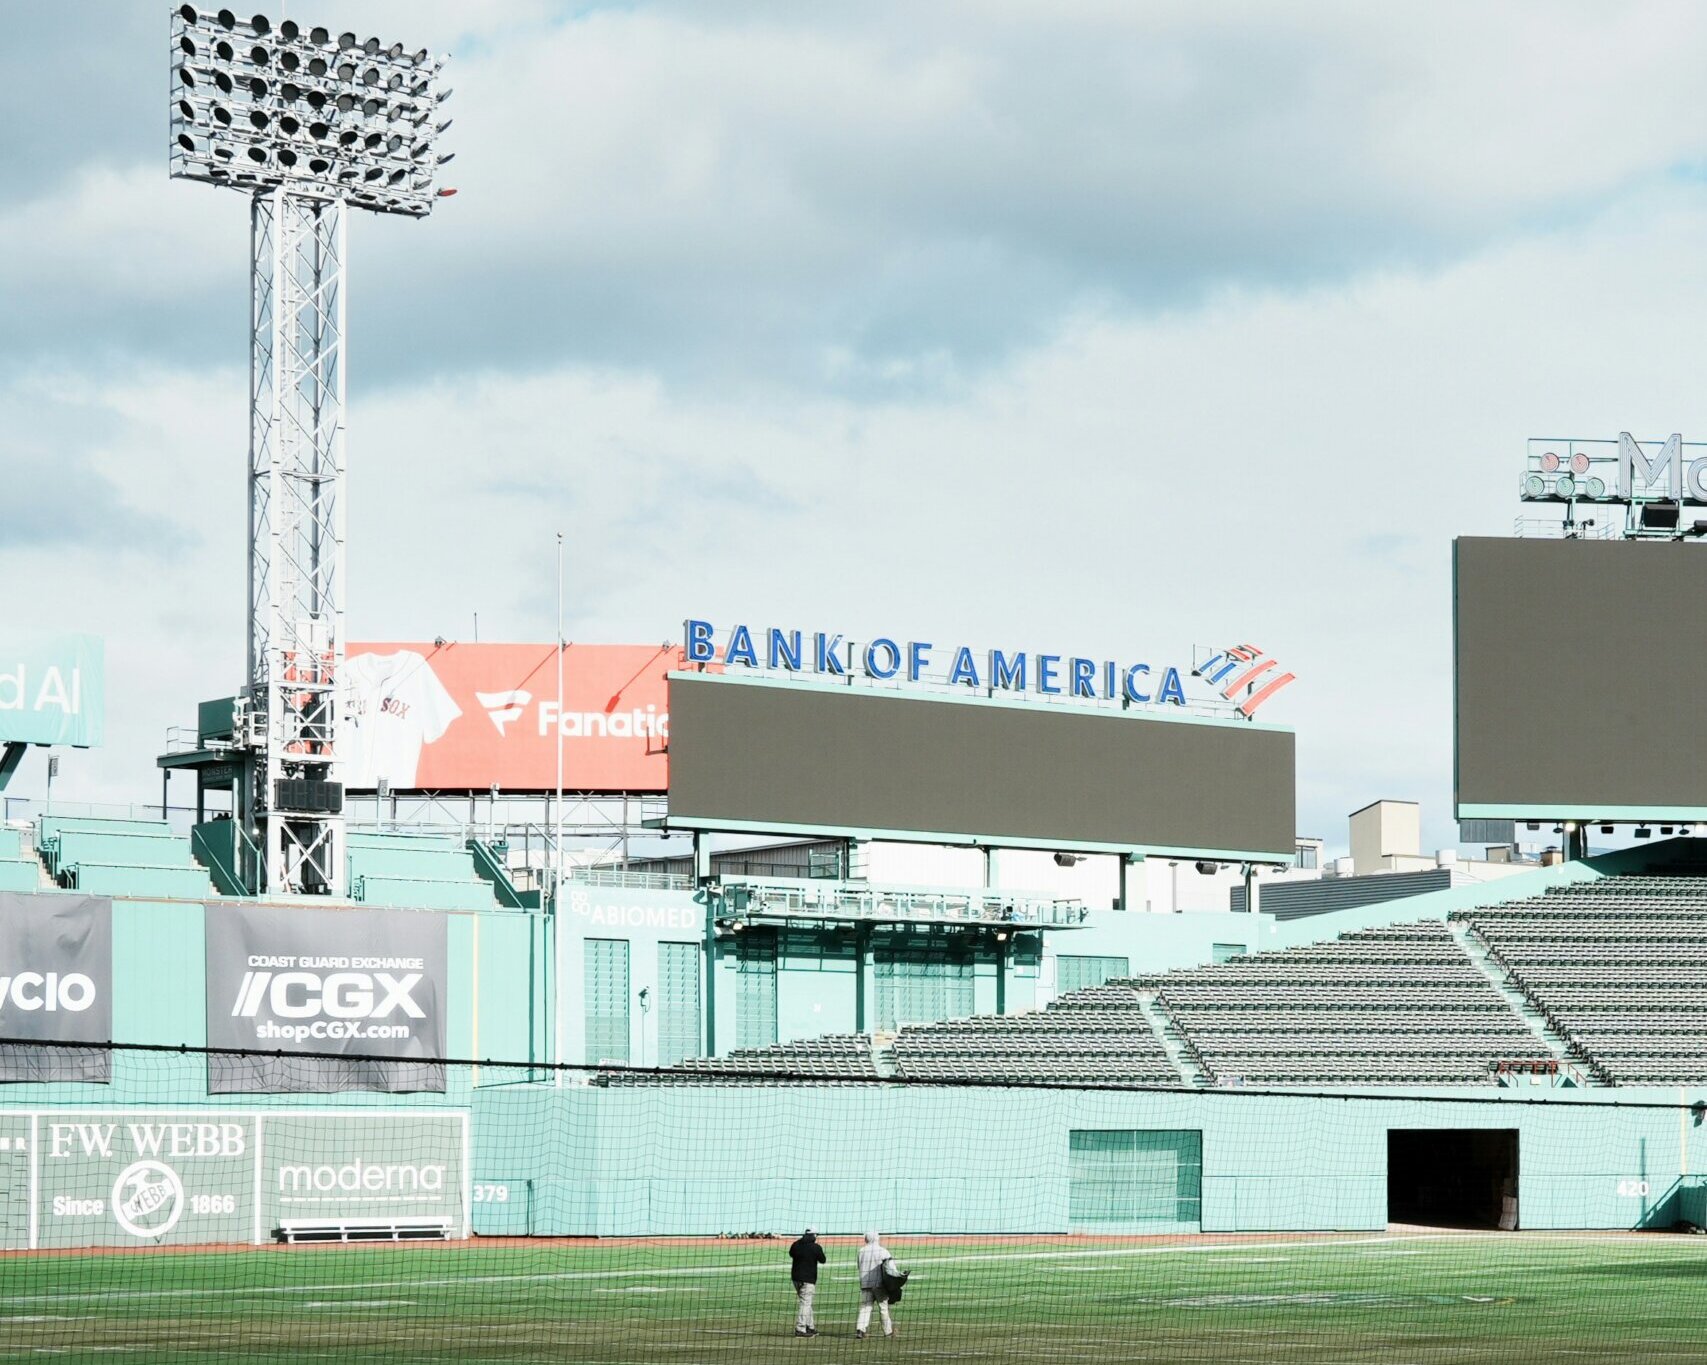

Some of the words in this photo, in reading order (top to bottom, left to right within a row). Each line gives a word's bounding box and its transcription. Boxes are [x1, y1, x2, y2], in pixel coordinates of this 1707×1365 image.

[685, 618, 846, 676] BANK
[863, 637, 933, 682] OF
[947, 645, 1187, 706] AMERICA
[33, 666, 80, 715] AI
[380, 697, 411, 720] SOX
[590, 904, 697, 929] ABIOMED
[248, 955, 297, 968] COAST
[299, 956, 349, 969] GUARD
[351, 957, 424, 970] EXCHANGE
[256, 1020, 410, 1043] shopCGX.com
[48, 1123, 118, 1158] F.W.
[127, 1123, 246, 1157] WEBB
[279, 1157, 445, 1191] moderna
[473, 1184, 508, 1203] 379
[1616, 1180, 1649, 1197] 420
[53, 1195, 105, 1217] Since
[190, 1194, 235, 1214] 1866
